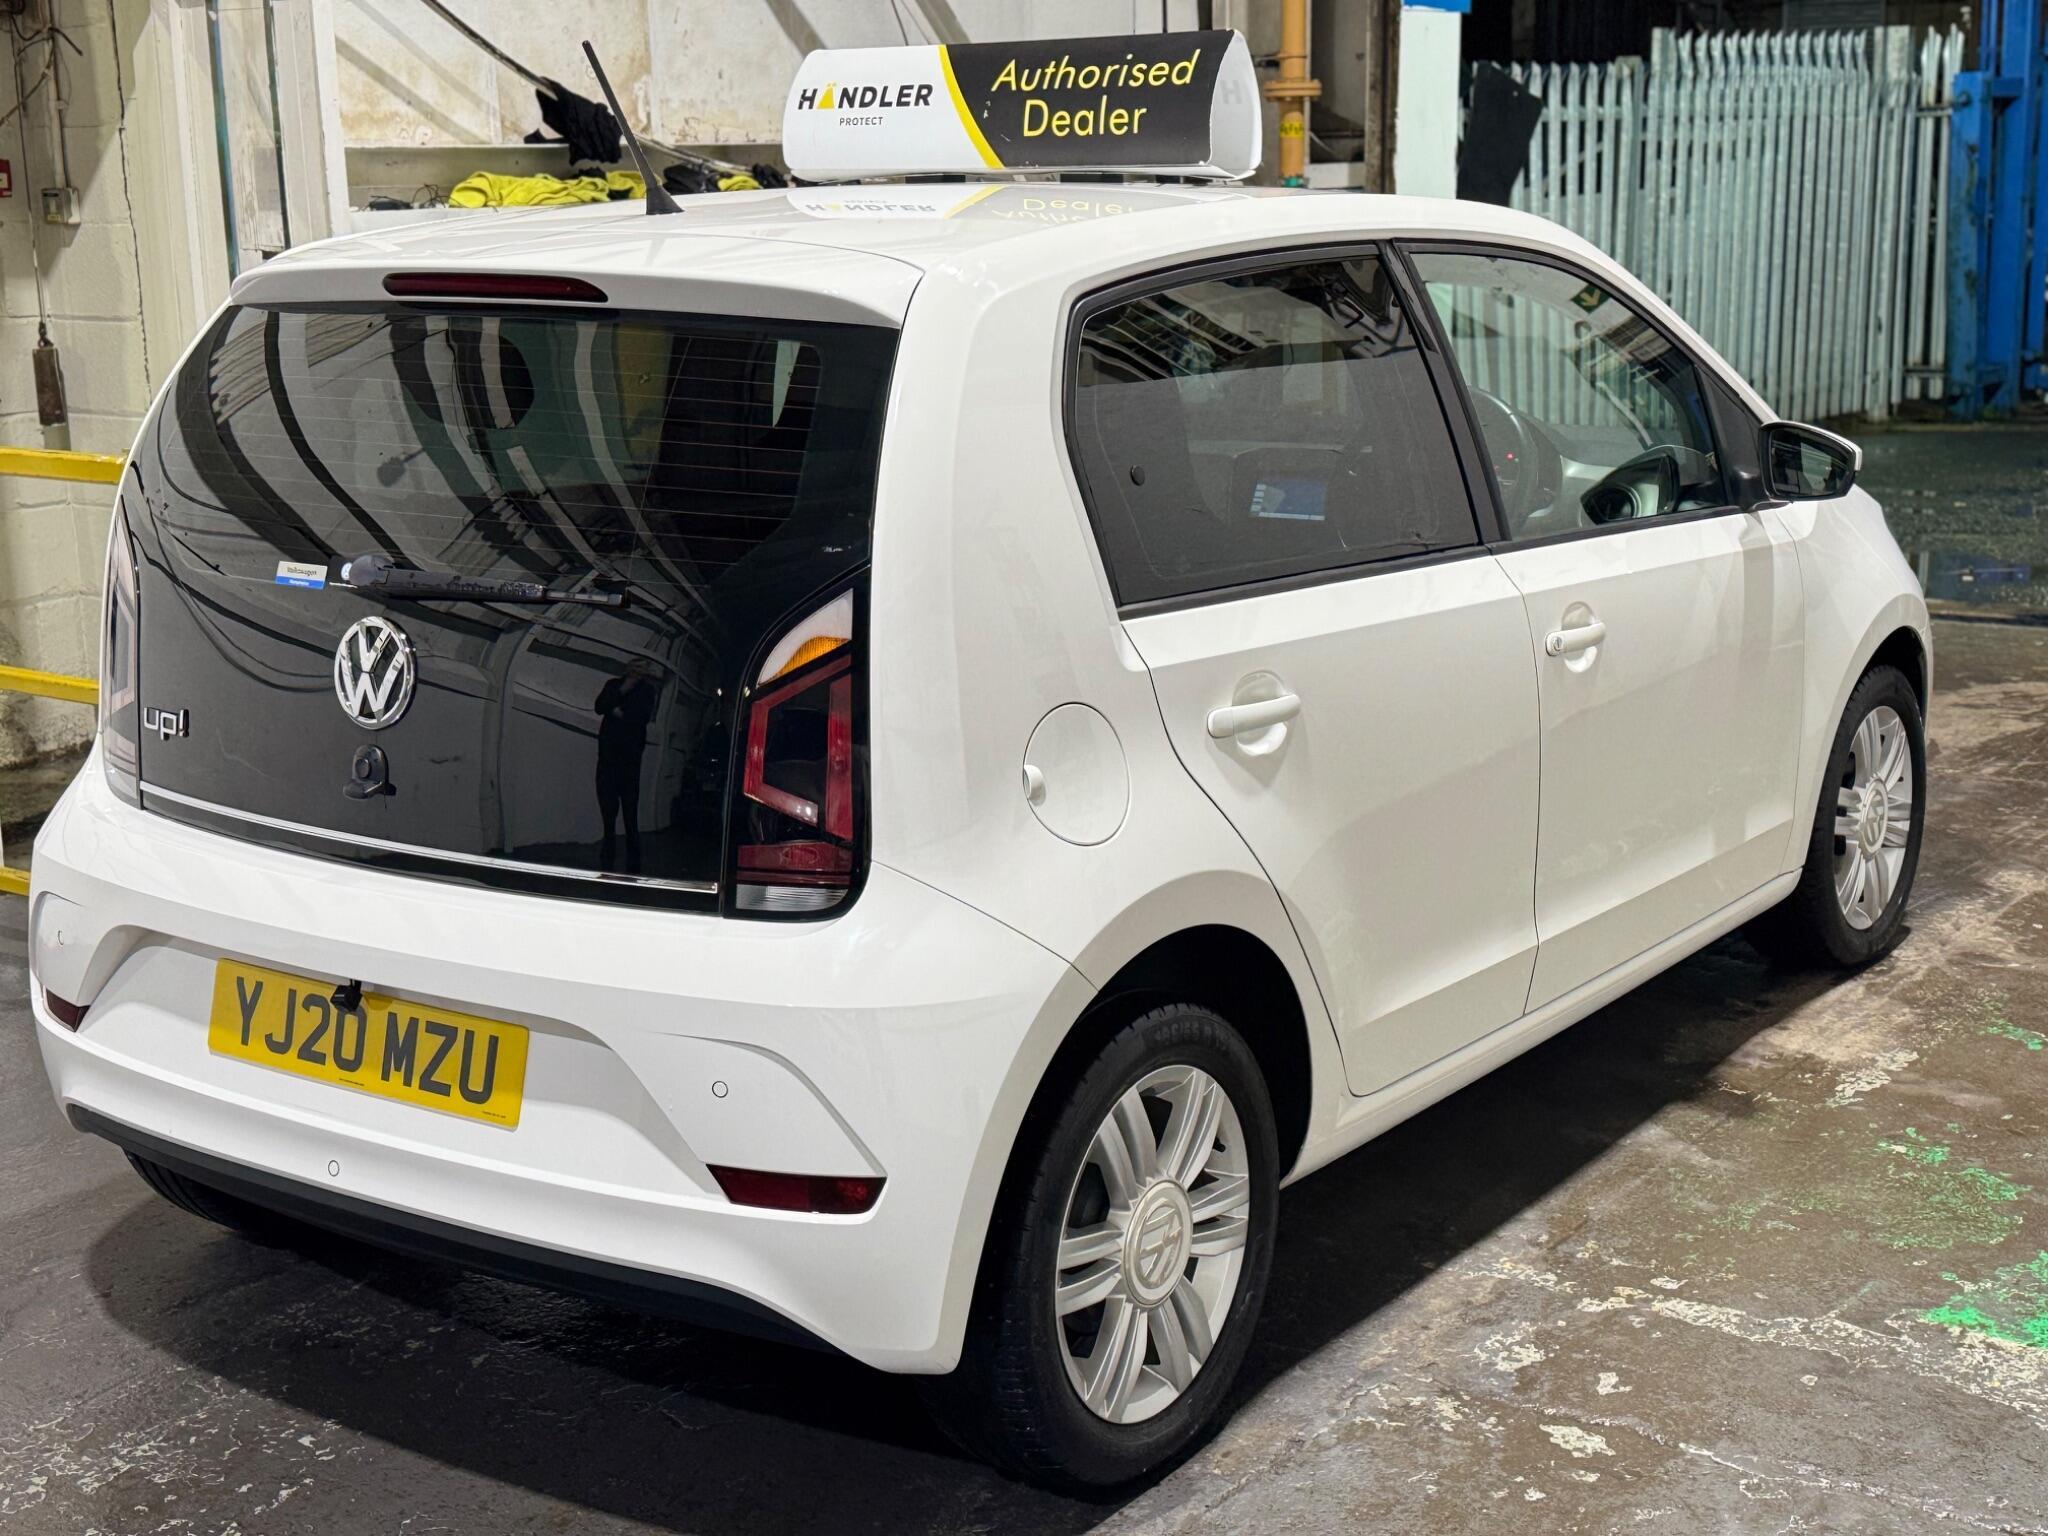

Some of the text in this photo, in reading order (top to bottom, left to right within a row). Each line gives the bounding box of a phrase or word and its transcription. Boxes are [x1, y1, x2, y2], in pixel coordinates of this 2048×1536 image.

[991, 48, 1201, 92] Authorised
[839, 116, 884, 126] PROTECT
[1023, 94, 1147, 137] Dealer
[143, 706, 190, 740] up!
[236, 975, 499, 1105] YJ20 MZU
